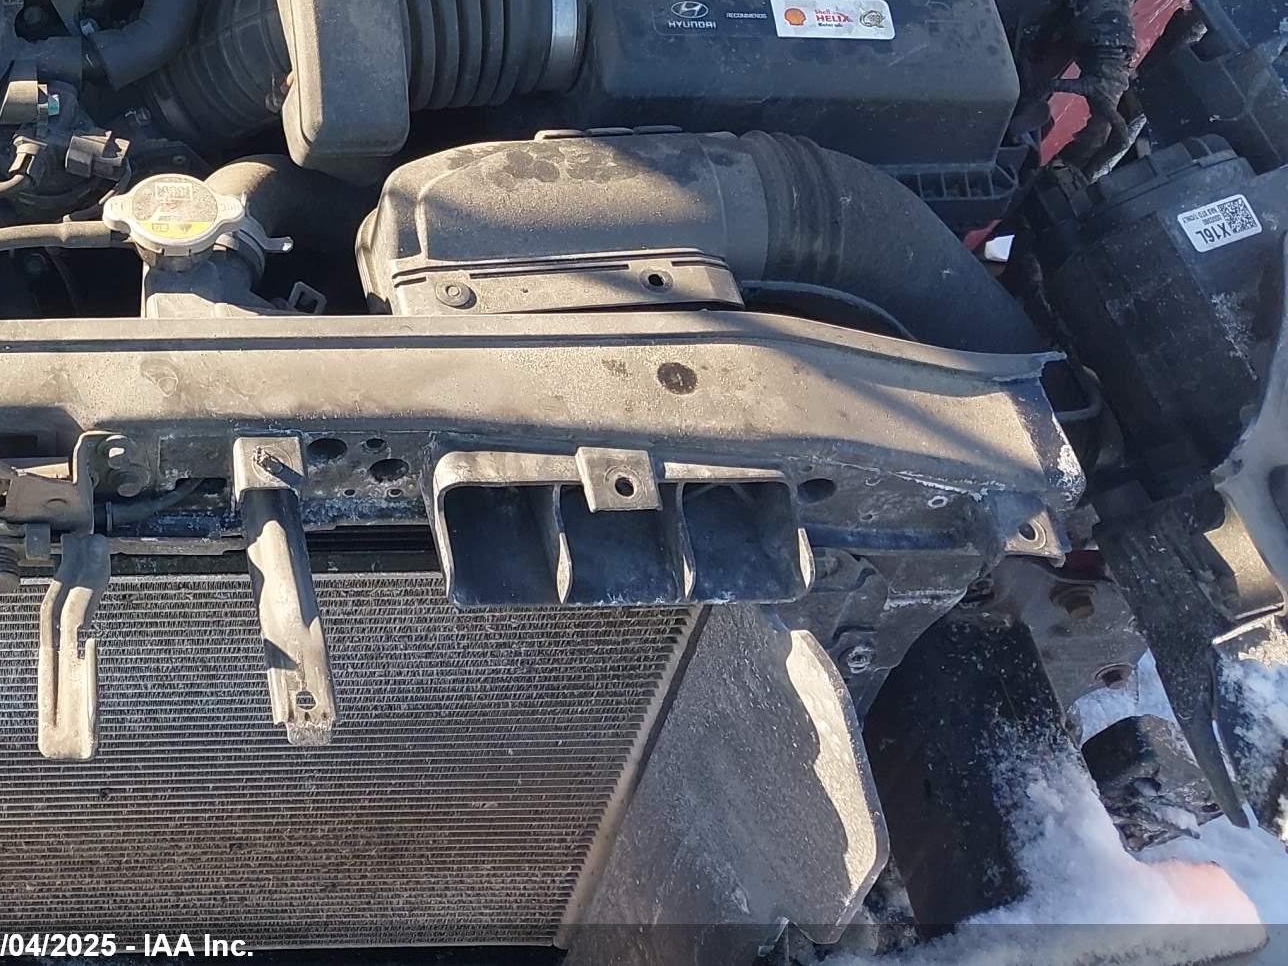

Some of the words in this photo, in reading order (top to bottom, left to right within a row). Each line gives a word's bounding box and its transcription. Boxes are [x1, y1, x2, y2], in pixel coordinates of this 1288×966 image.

[816, 15, 852, 23] HELIX
[667, 21, 716, 30] HYUNDAI
[1195, 222, 1232, 244] X16L
